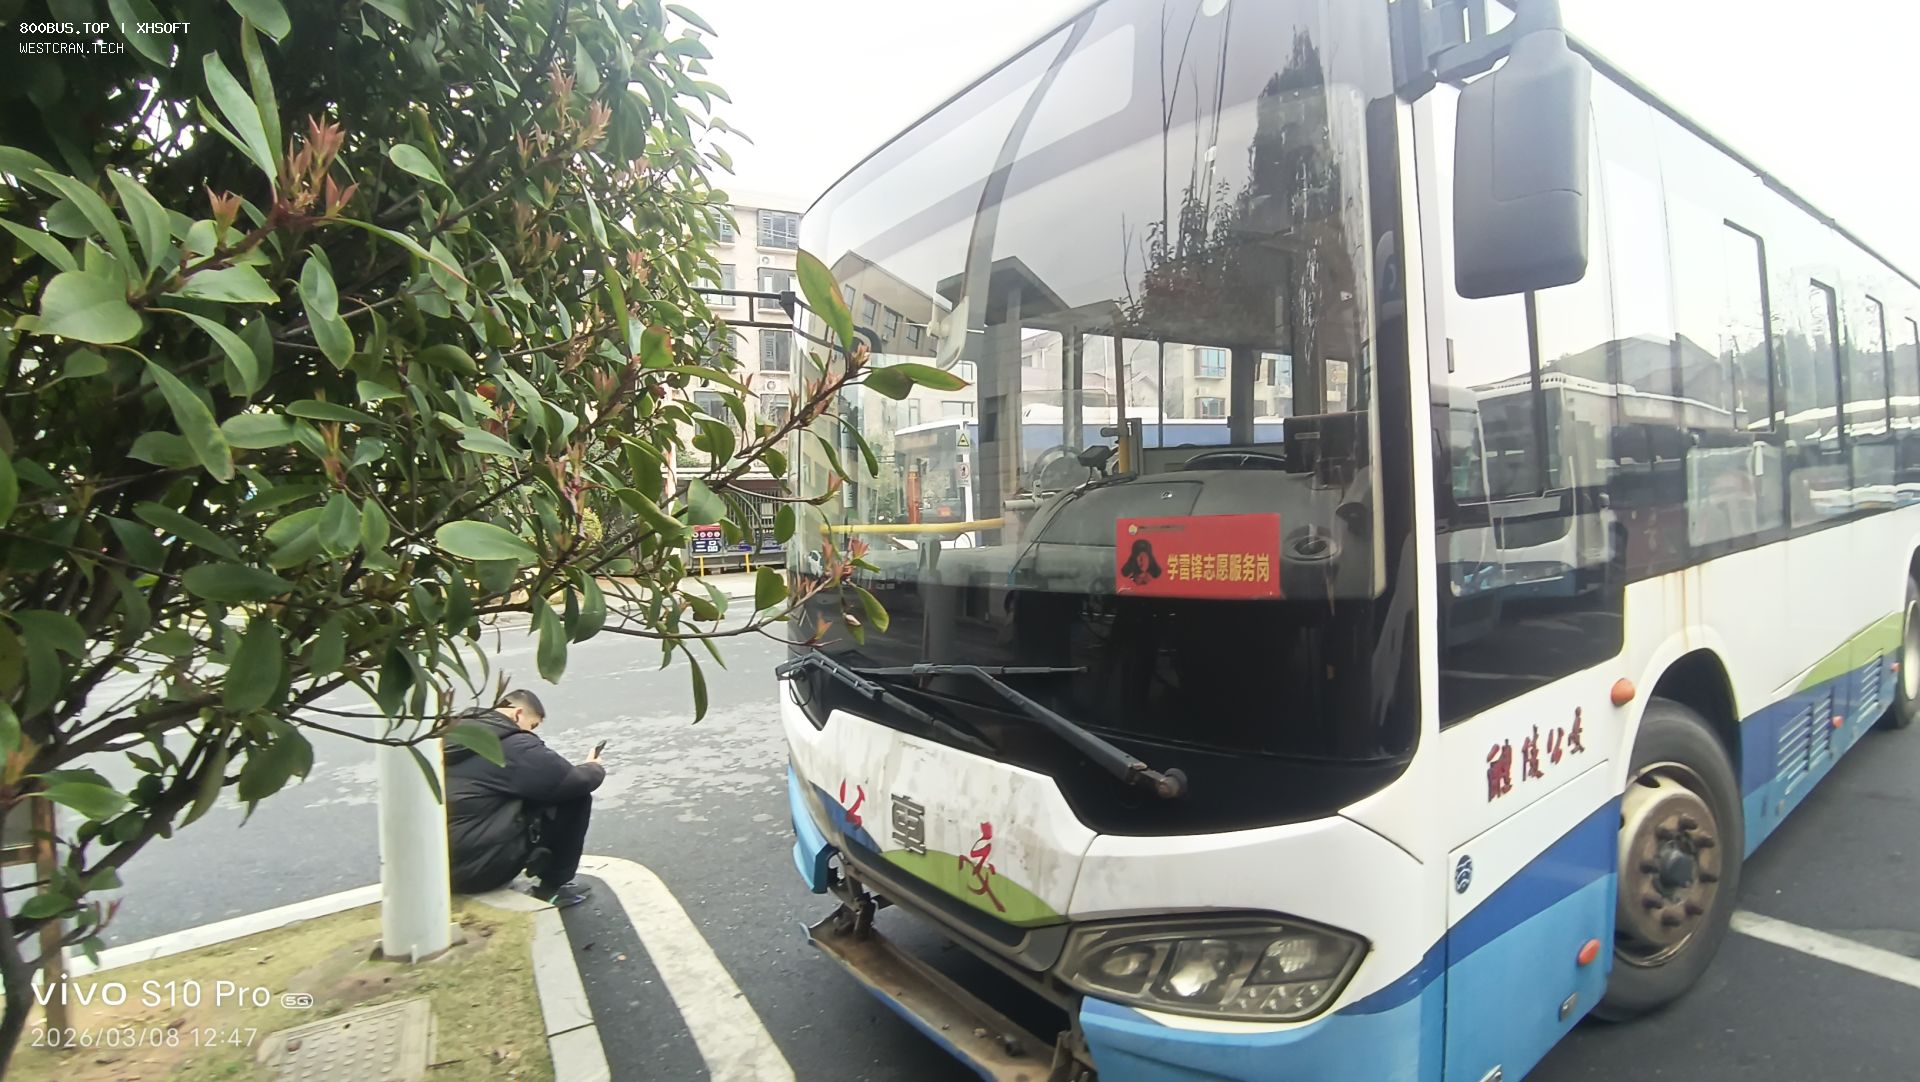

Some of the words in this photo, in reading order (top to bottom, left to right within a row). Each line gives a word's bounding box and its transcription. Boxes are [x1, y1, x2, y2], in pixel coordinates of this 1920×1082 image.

[1167, 553, 1270, 582] 学雷锋志愿服务岗
